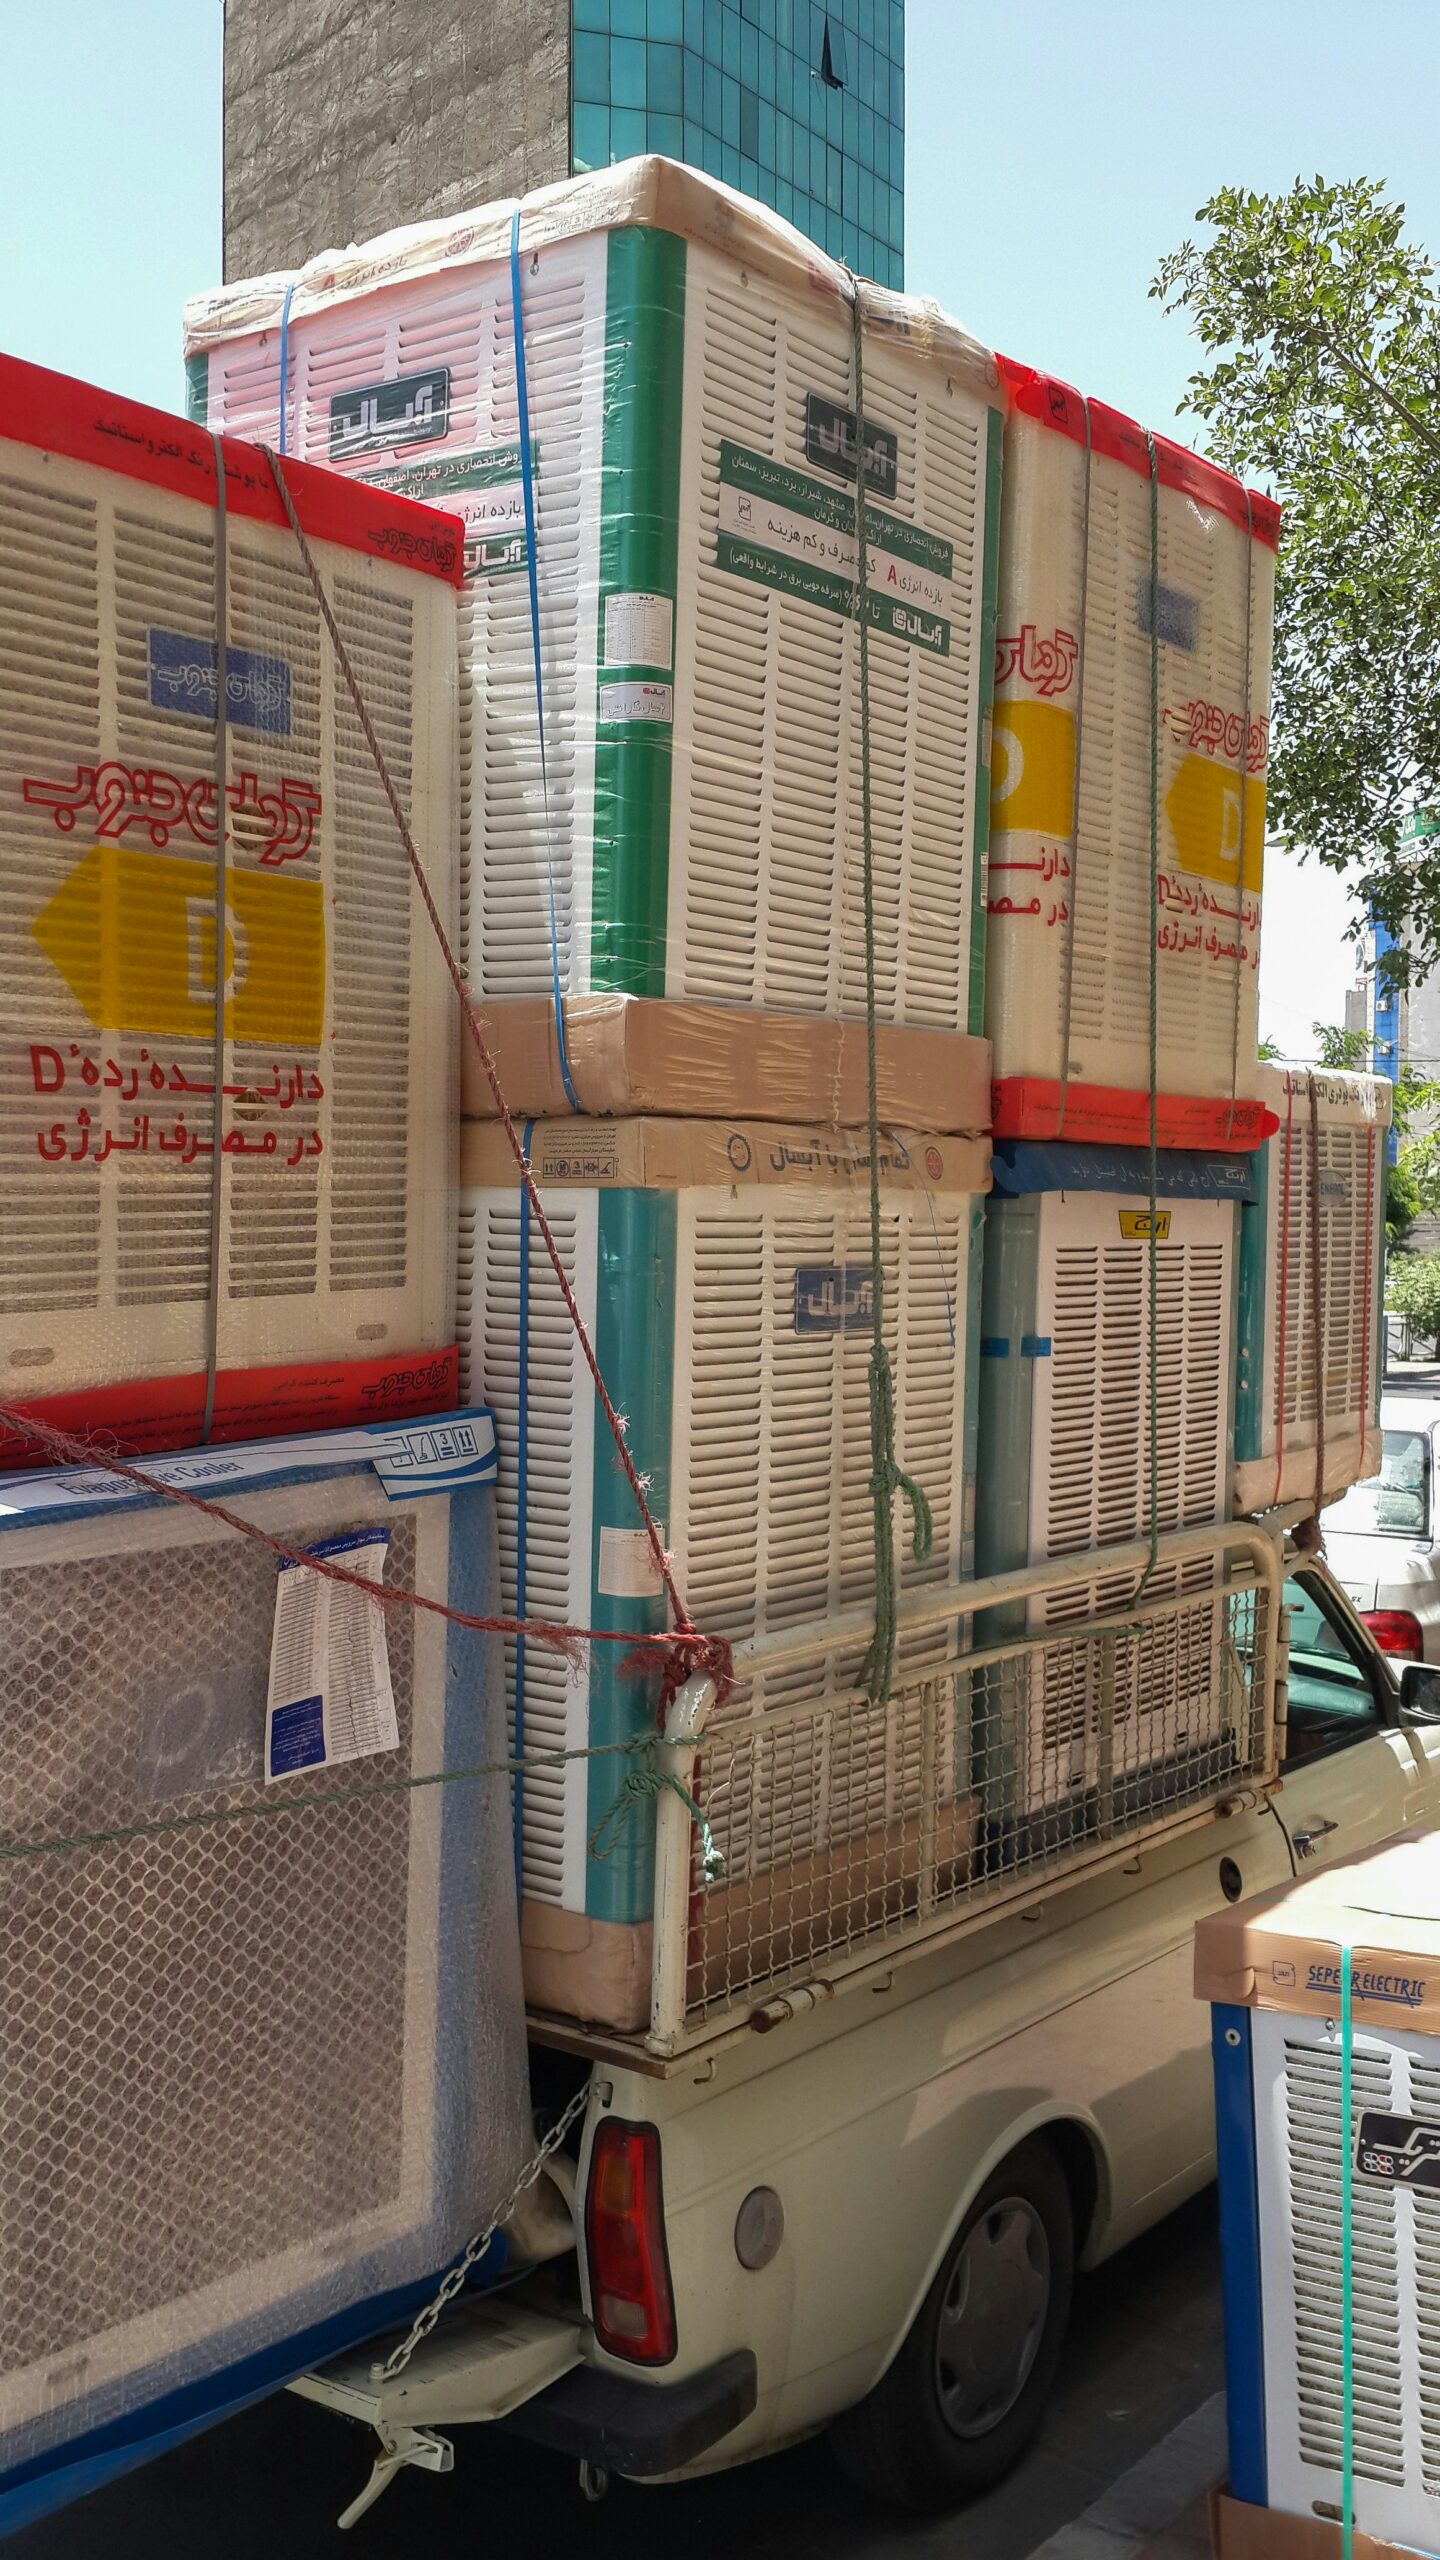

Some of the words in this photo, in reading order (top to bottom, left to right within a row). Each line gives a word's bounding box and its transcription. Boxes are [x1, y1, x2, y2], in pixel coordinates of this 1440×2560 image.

[343, 385, 433, 439] آبسال
[444, 464, 456, 477] در
[457, 454, 497, 476] انحصاری
[731, 454, 758, 473] سمنان
[491, 499, 522, 520] بازده
[813, 506, 835, 525] کرمان
[767, 518, 801, 543] هزینه
[802, 532, 818, 552] کم
[819, 541, 826, 557] و
[886, 564, 898, 586] A
[899, 572, 923, 597] انرژی
[924, 586, 944, 606] بازده
[906, 612, 943, 648] آبسال
[1048, 900, 1070, 927] در
[1157, 921, 1203, 953] انرژی
[186, 896, 251, 1004] D
[29, 1044, 66, 1093] D
[37, 1107, 151, 1162] انرژی
[159, 1112, 278, 1164] مصرف
[288, 1128, 325, 1166] در
[769, 1138, 823, 1172] آبسال
[439, 1433, 450, 1445] 3
[180, 1459, 245, 1484] Cooler
[1308, 1964, 1360, 1992] SEPER
[1363, 1972, 1426, 2001] ELECTRIC
